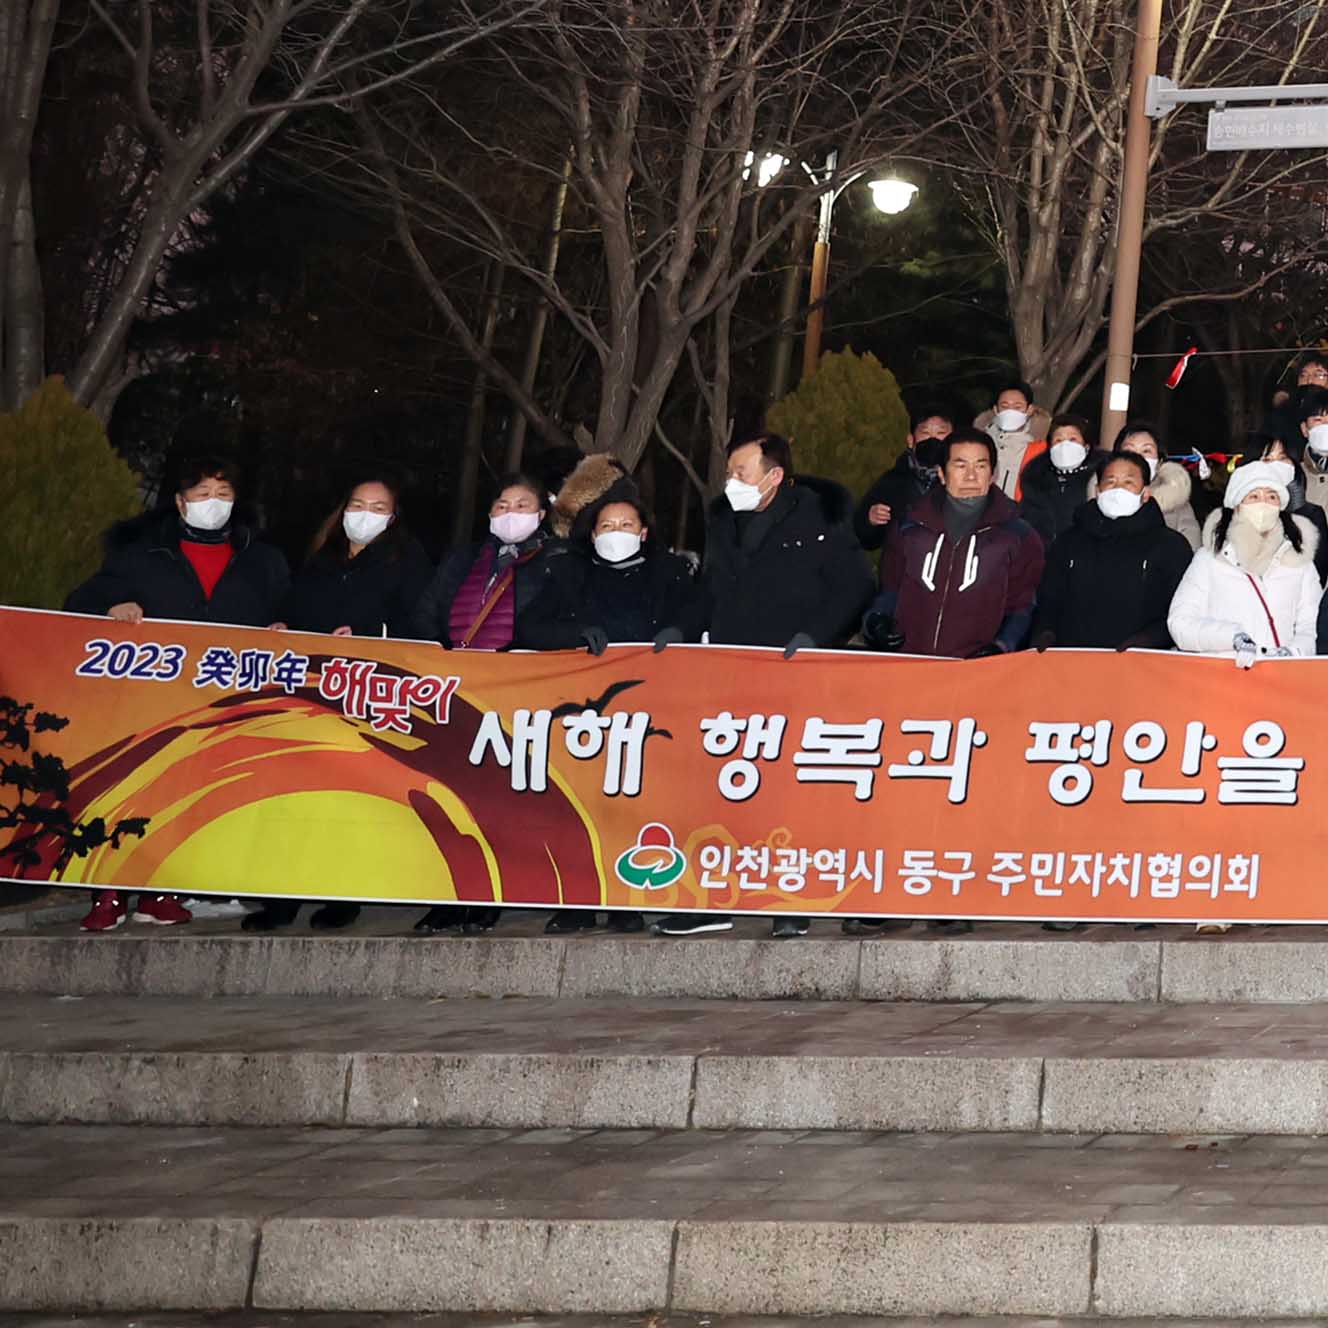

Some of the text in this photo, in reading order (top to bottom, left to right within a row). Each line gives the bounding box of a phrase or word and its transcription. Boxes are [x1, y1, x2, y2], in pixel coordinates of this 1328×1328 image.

[75, 638, 458, 735] 2023 癸卯年 해맞이
[467, 709, 650, 798] 새해
[700, 710, 987, 804] 행복과
[1025, 717, 1305, 807] 평안을
[698, 845, 1260, 899] 인천광역시 동구 주민자치협의회
